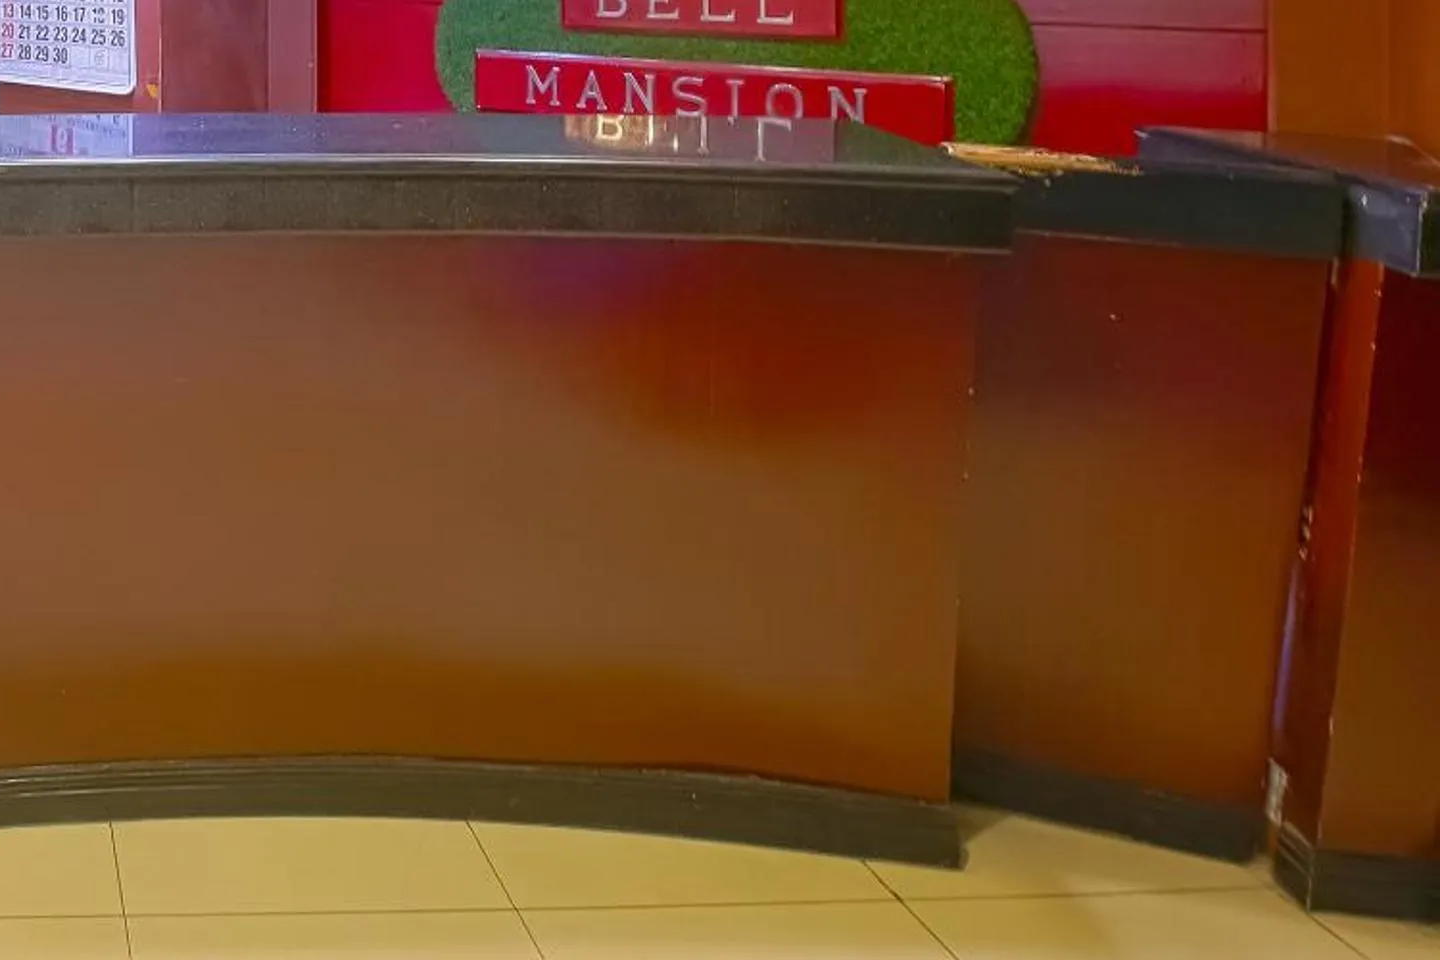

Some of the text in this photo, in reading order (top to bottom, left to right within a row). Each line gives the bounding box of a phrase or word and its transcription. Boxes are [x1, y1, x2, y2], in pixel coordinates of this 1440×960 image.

[2, 4, 14, 18] 13
[20, 5, 32, 19] 14
[37, 5, 49, 20] 15
[55, 7, 68, 22] 16
[74, 7, 86, 23] 17
[112, 9, 124, 25] 19
[1, 23, 125, 47] 20 21 22 23 24 25 26
[1, 43, 68, 64] 27 28 29 30
[525, 64, 869, 124] MANSION
